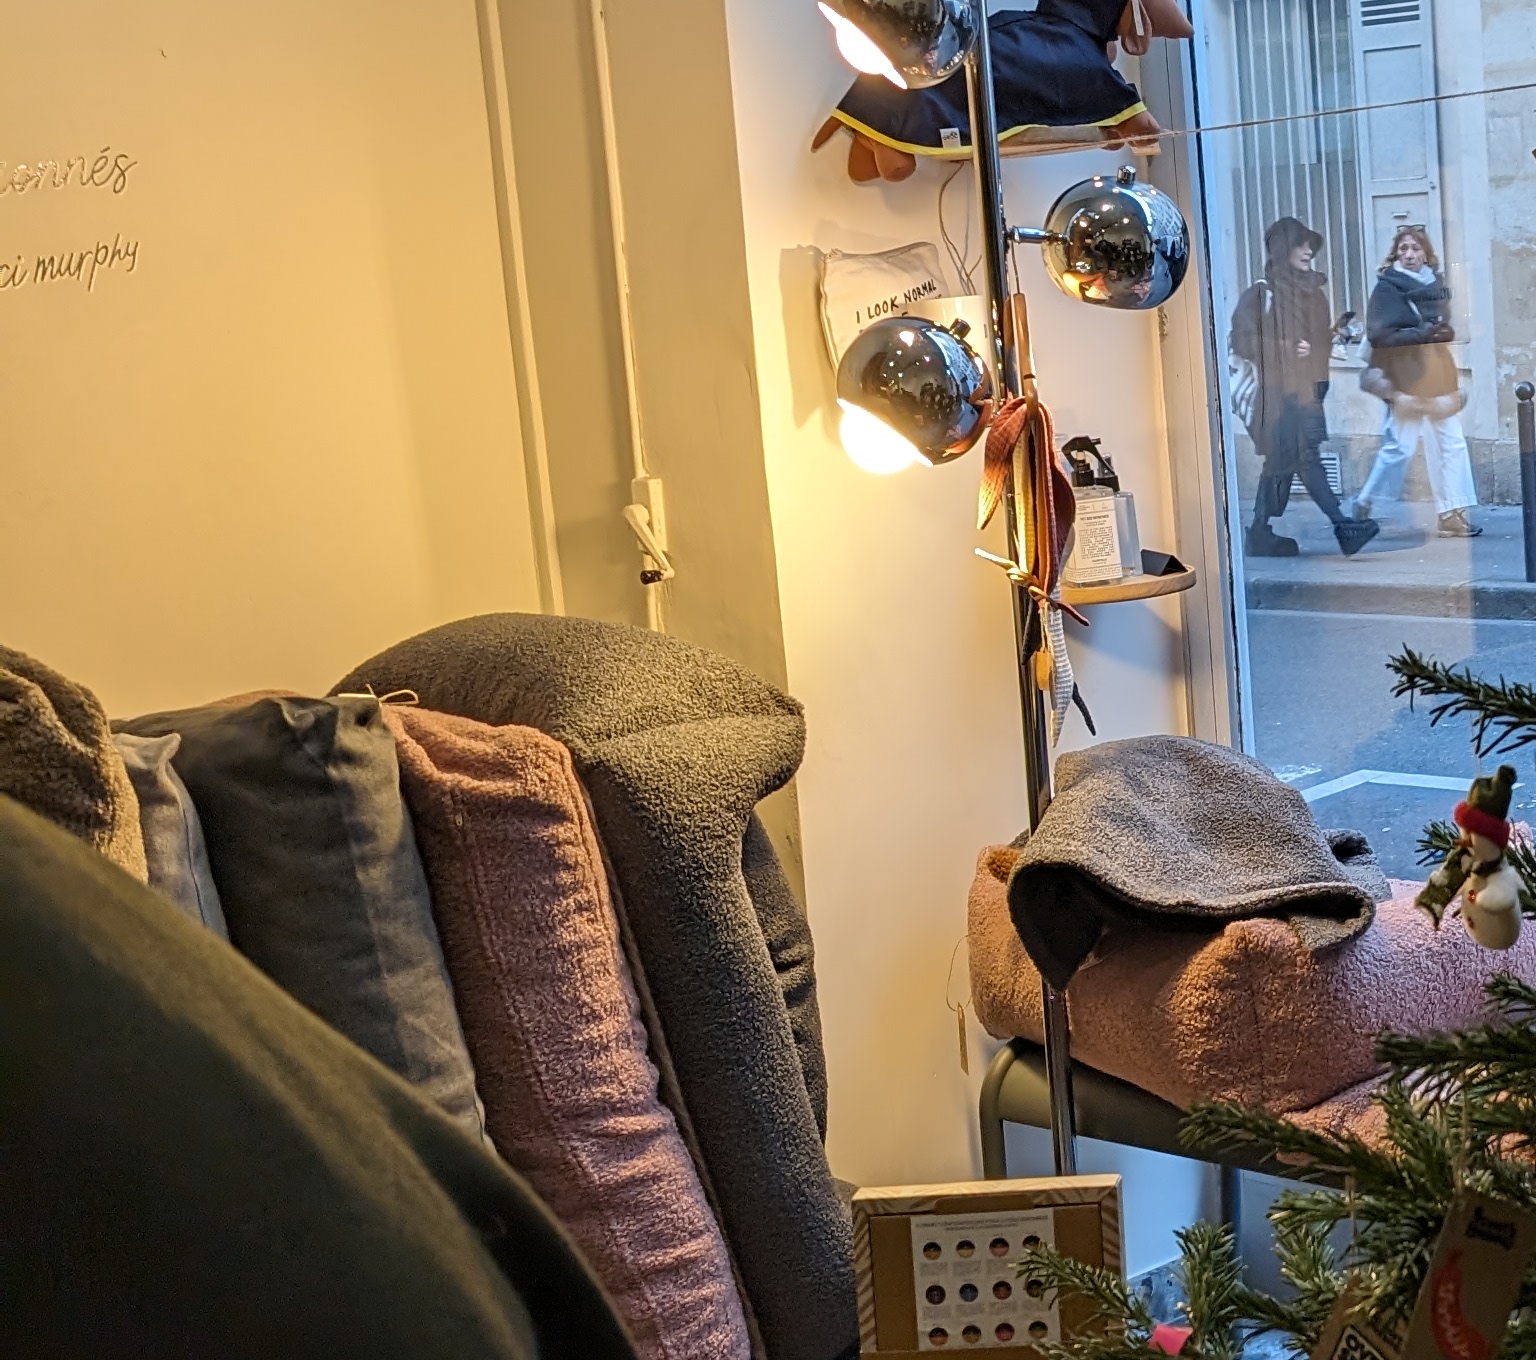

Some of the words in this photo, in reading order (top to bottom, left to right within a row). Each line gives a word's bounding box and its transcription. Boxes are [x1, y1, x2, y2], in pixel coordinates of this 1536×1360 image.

[34, 233, 139, 292] murphy
[867, 296, 899, 320] LOOK
[903, 279, 937, 304] NORMAL
